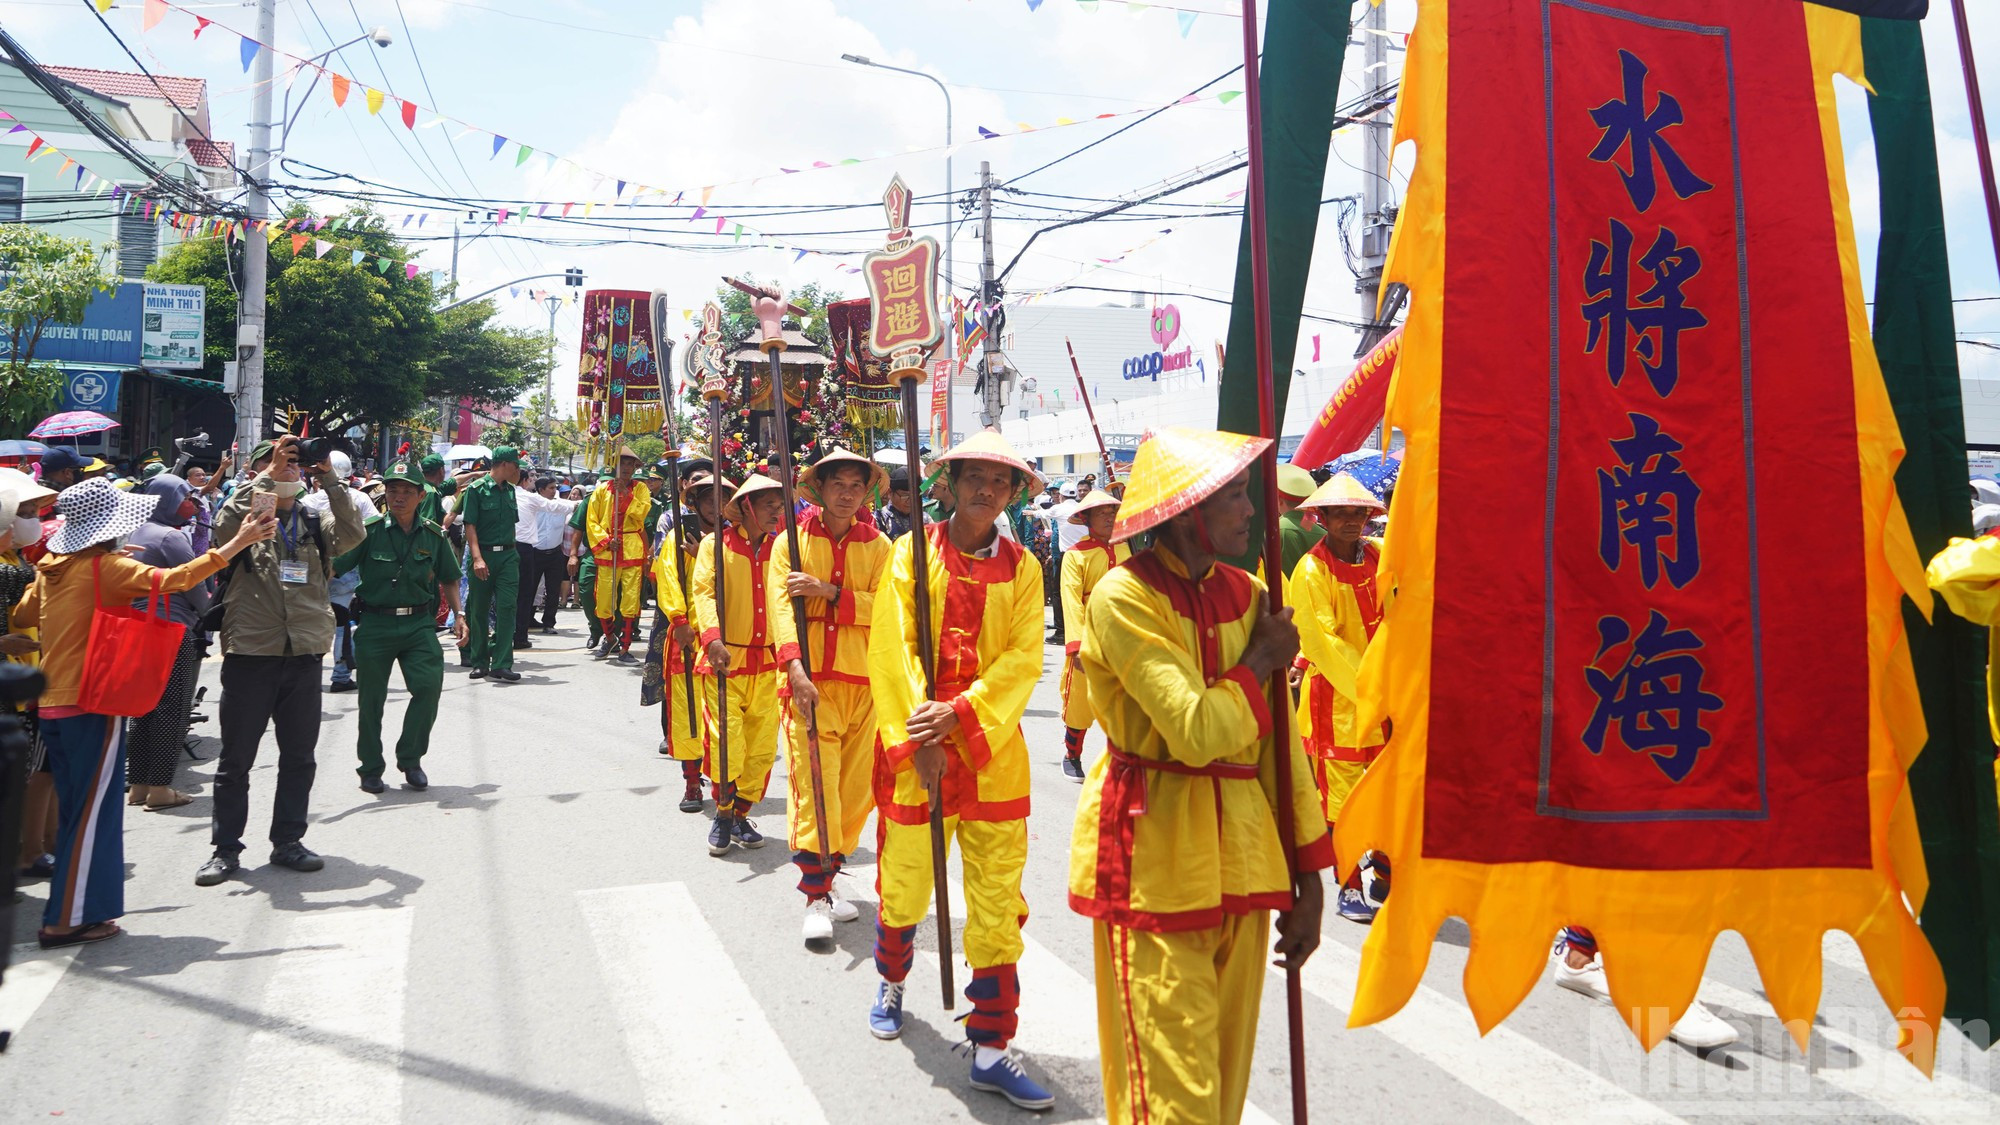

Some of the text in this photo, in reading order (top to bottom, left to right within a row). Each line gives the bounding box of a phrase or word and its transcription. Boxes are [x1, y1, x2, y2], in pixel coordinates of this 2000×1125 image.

[147, 287, 201, 298] NHÀ THUỐC
[146, 297, 174, 308] MINH
[196, 299, 201, 310] 1
[881, 263, 922, 341] 迴避
[82, 328, 99, 343] THỊ
[101, 329, 132, 342] ĐOAN
